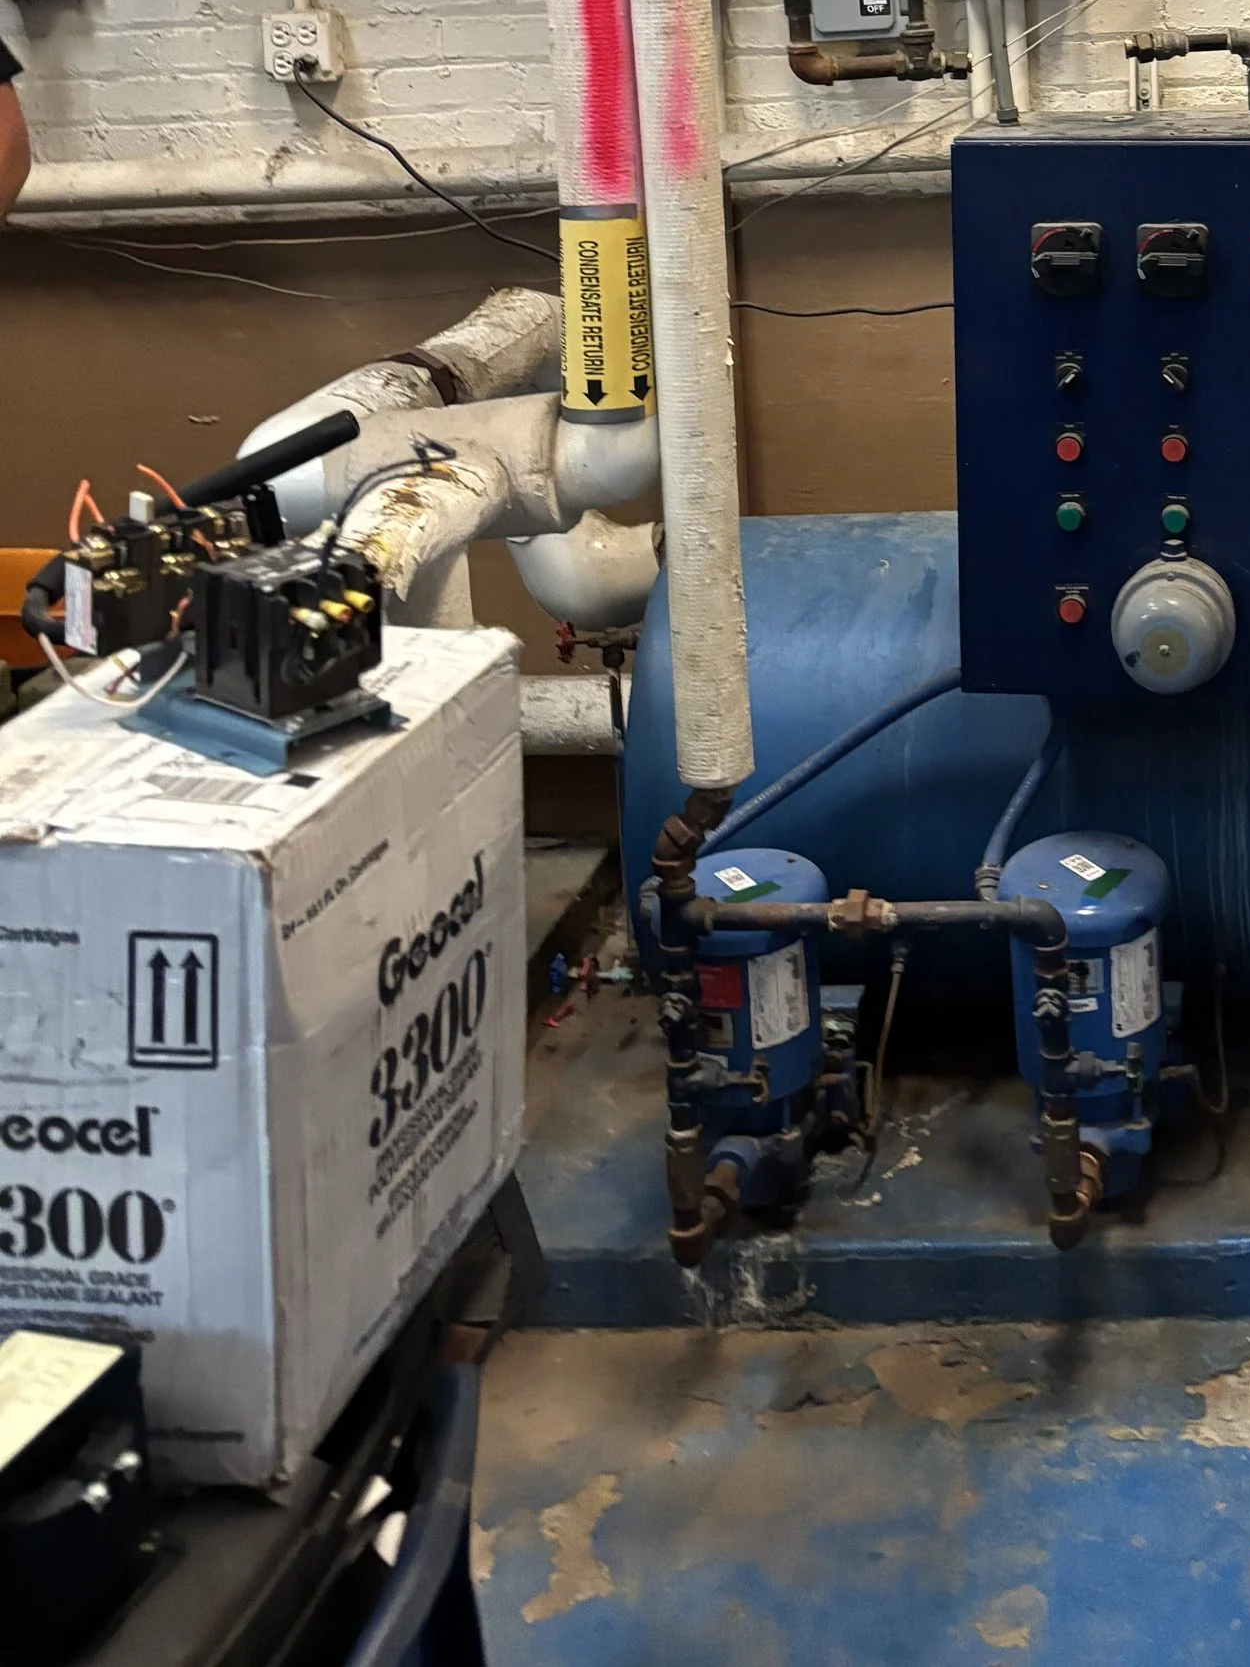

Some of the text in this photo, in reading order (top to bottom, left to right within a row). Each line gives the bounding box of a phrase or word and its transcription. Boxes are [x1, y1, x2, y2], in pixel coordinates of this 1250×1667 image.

[867, 5, 885, 13] OFF
[578, 240, 605, 376] CONDENSATE RETURN
[625, 236, 651, 372] CONDENSATE RETURN
[378, 850, 484, 1007] Geocel
[369, 948, 488, 1149] 3300
[0, 1106, 153, 1157] eocel
[0, 1185, 166, 1265] 300
